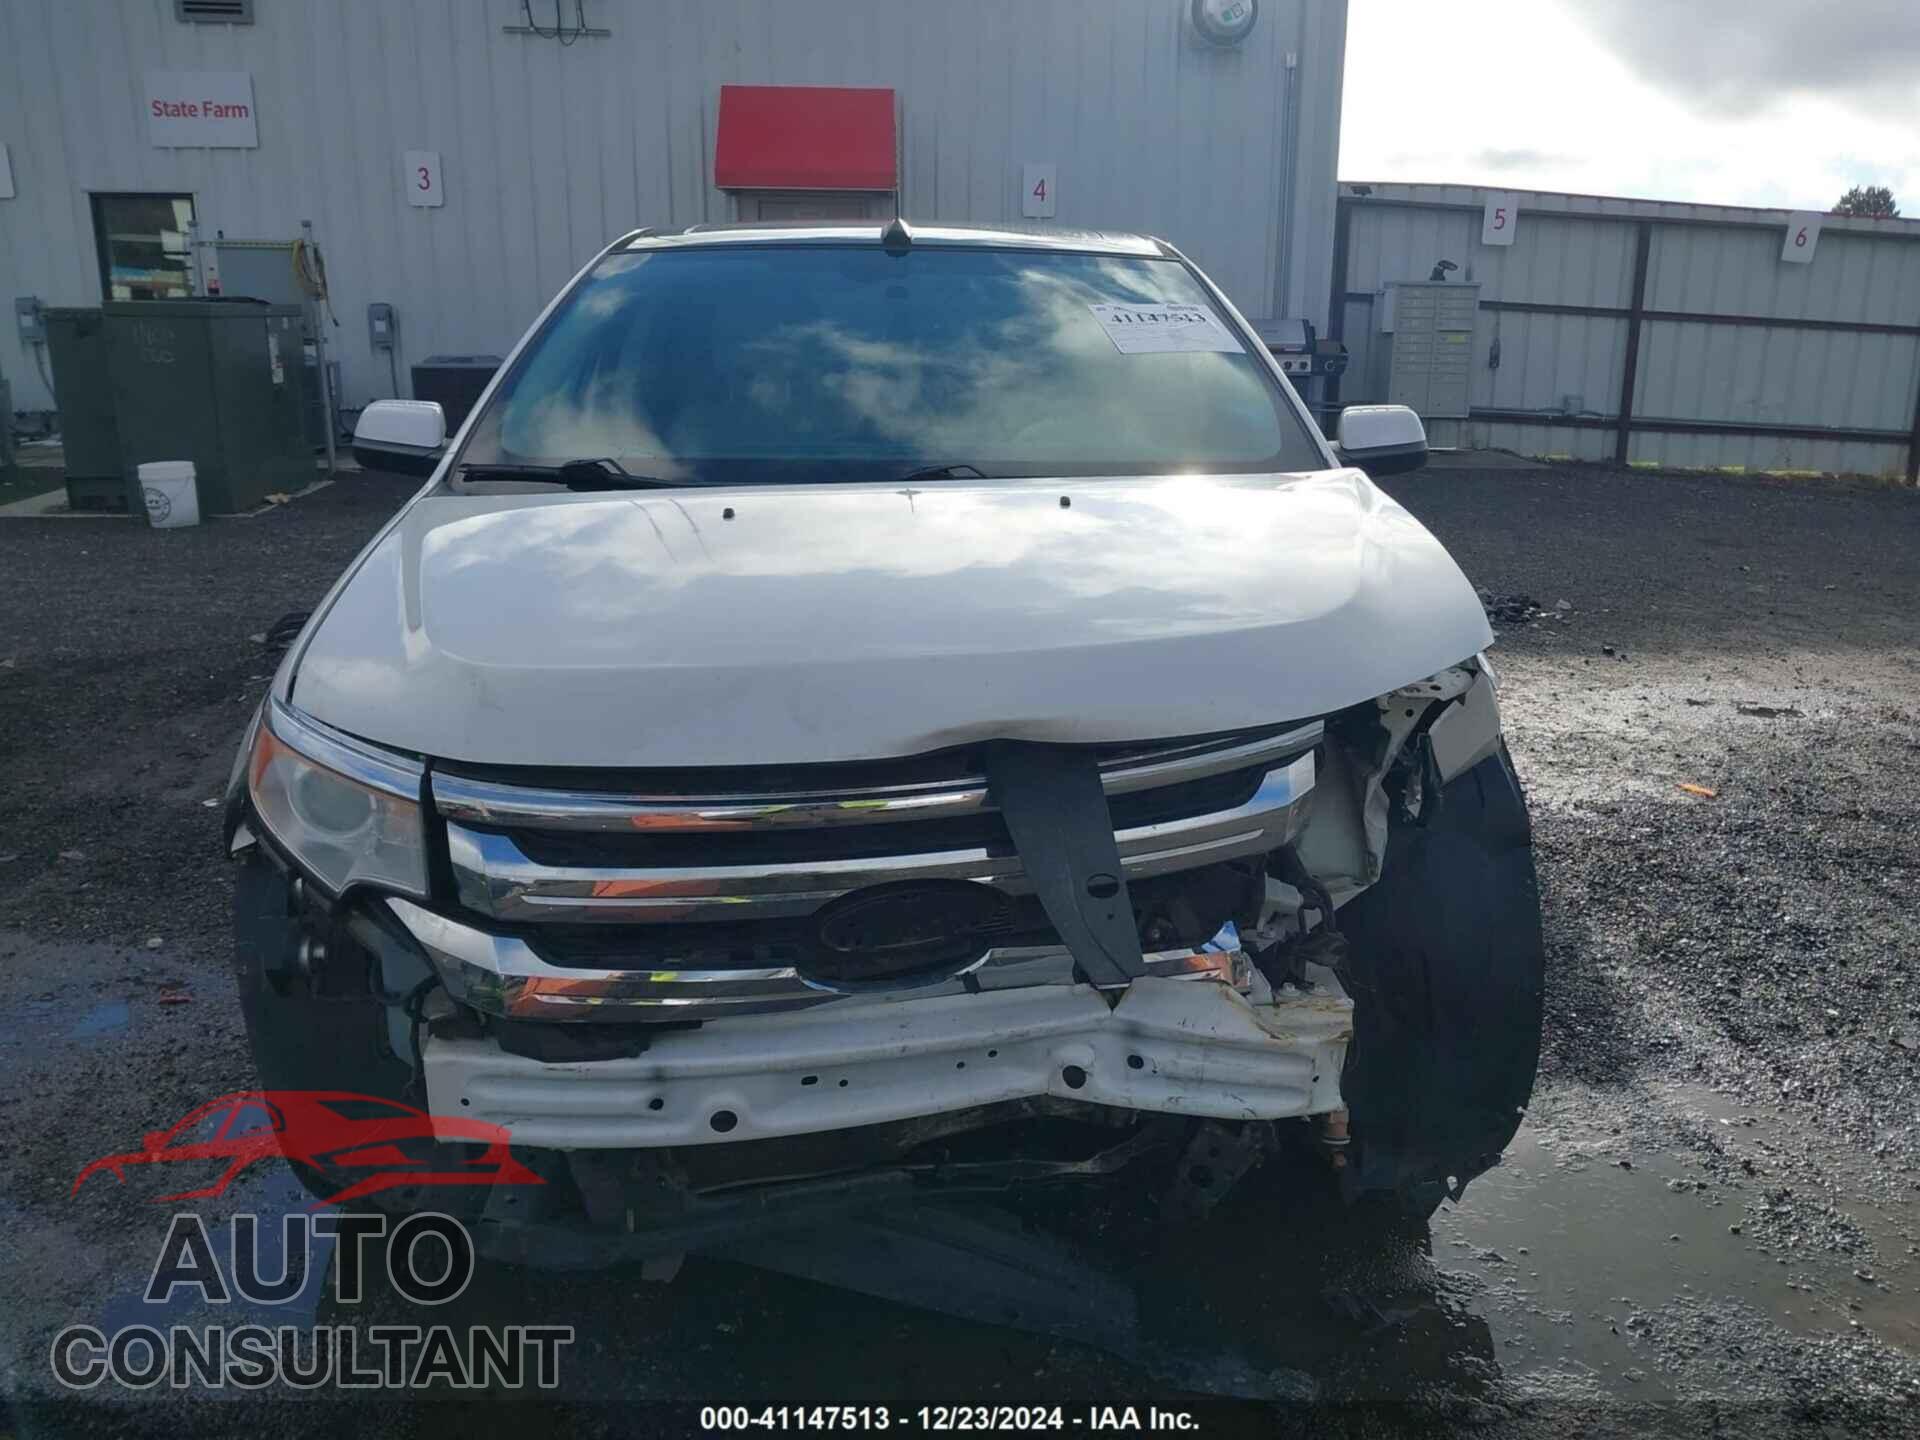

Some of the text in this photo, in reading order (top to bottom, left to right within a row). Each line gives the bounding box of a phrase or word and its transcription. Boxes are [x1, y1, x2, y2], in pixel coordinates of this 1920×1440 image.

[152, 100, 249, 117] State Farm
[418, 168, 430, 190] 3
[1033, 179, 1046, 201] 4
[1493, 208, 1505, 230] 5
[1794, 228, 1806, 248] 6
